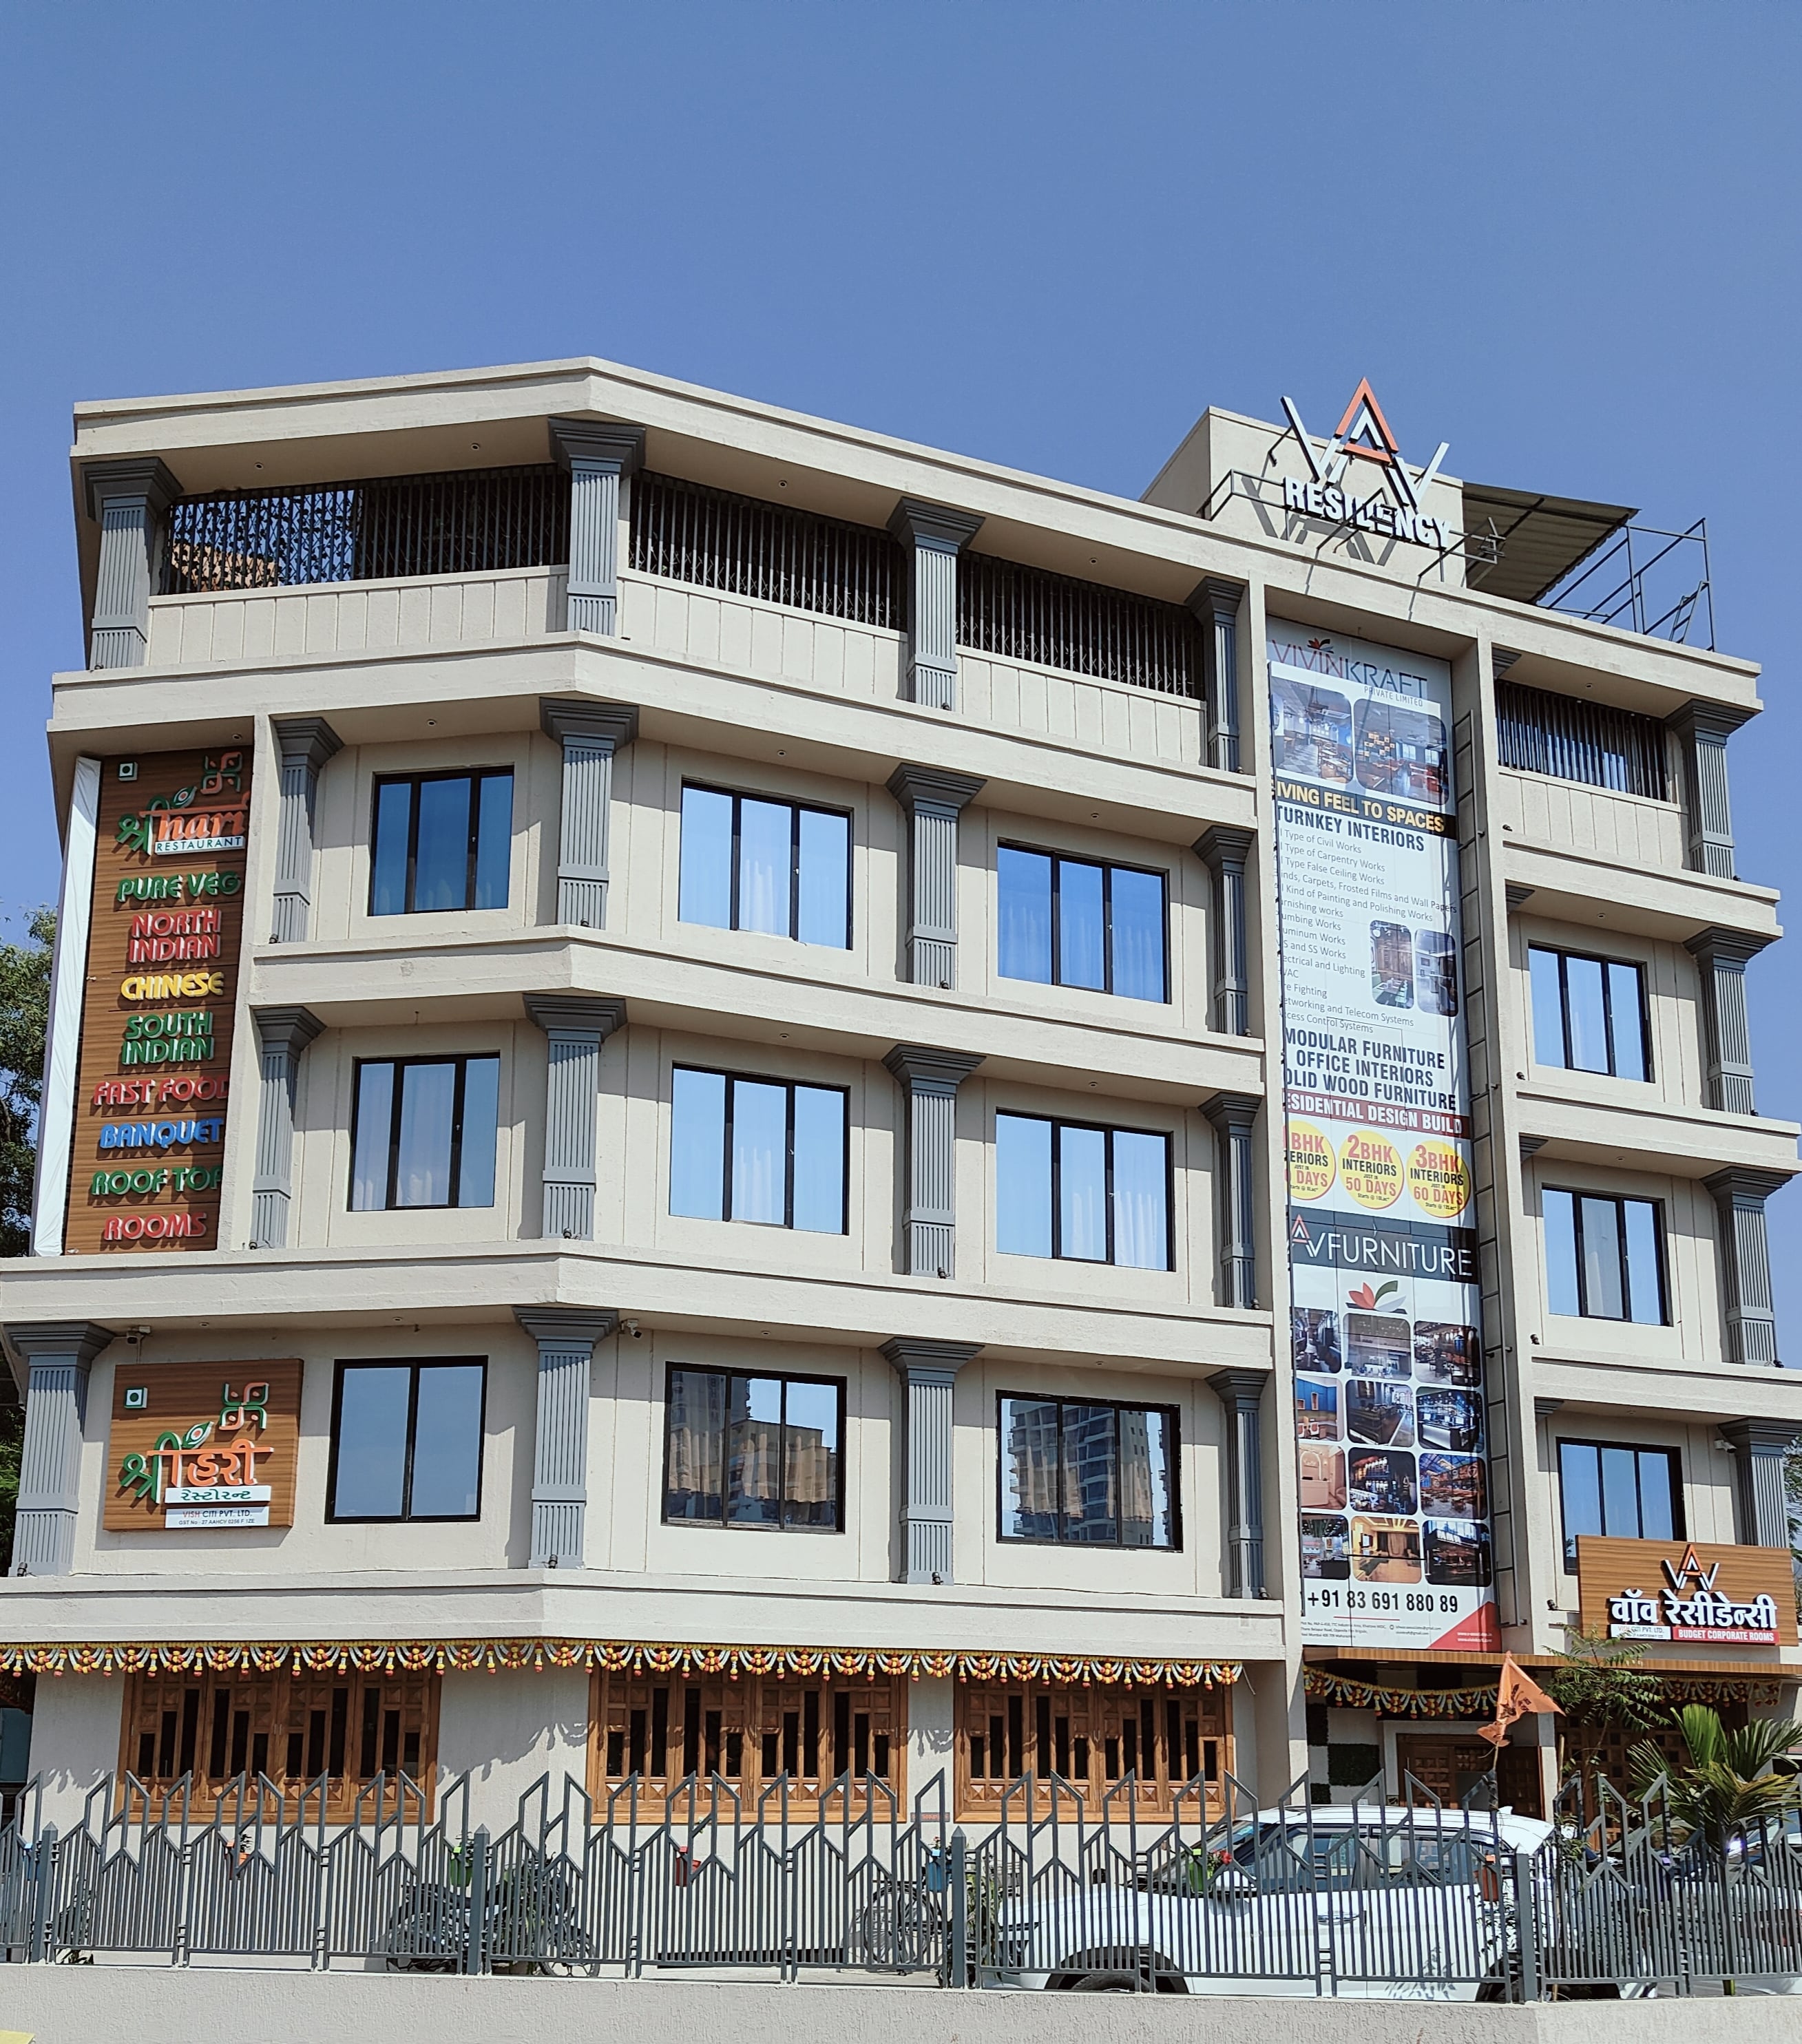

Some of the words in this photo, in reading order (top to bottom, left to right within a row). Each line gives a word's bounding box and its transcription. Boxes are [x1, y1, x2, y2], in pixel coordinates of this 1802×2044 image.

[1364, 686, 1394, 700] PRIVATE
[1395, 694, 1423, 707] LIMITED
[1277, 781, 1319, 805] IVING
[1324, 792, 1359, 814] FEEL
[1361, 800, 1383, 819] TO
[1387, 805, 1445, 832] SPACES
[157, 836, 241, 852] RESTAURANT
[1284, 829, 1304, 841] Type
[1317, 836, 1333, 847] Civil
[1336, 841, 1361, 853] Works
[1348, 820, 1424, 851] INTERIORS
[1284, 843, 1305, 854] Type
[1317, 850, 1358, 867] Carpentry
[1360, 859, 1385, 872] Works
[1285, 856, 1305, 868] Type
[1308, 862, 1328, 873] False
[1330, 867, 1357, 881] Ceiling
[1359, 872, 1384, 885] Works
[117, 875, 182, 902] PURE
[187, 871, 240, 896] VEG
[1281, 871, 1300, 883] inds,
[1302, 874, 1337, 890] Carpets,
[1339, 882, 1368, 895] Frosted
[1371, 889, 1392, 900] Films
[1394, 895, 1409, 903] and
[1411, 896, 1428, 907] Wall
[1431, 900, 1457, 913] Papers
[1283, 900, 1317, 914] rnishing
[1319, 907, 1343, 917] works
[1286, 885, 1304, 896] Kind
[1317, 891, 1350, 907] Painting
[1352, 900, 1368, 909] and
[1370, 902, 1405, 918] Polishing
[1407, 909, 1432, 922] Works
[132, 909, 221, 937] NORTH
[1282, 914, 1313, 927] umbing
[1315, 918, 1341, 931] Works
[1283, 927, 1317, 940] uminum
[1319, 933, 1345, 945] Works
[129, 934, 220, 962] INDIAN
[1290, 943, 1306, 951] and
[1308, 945, 1318, 953] SS
[1320, 947, 1346, 959] Works
[1284, 956, 1312, 967] ectrical
[1314, 961, 1330, 970] and
[1333, 963, 1365, 978] Lighting
[121, 971, 225, 1000] CHINESE
[1294, 984, 1328, 999] Fighting
[126, 1011, 213, 1039] SOUTH
[1284, 998, 1325, 1013] etworking
[1327, 1005, 1343, 1013] and
[1345, 1007, 1379, 1020] Telecom
[1381, 1013, 1414, 1026] Systems
[1286, 1013, 1305, 1021] cess
[1307, 1014, 1338, 1027] Control
[1339, 1020, 1373, 1033] Systems
[122, 1037, 213, 1065] INDIAN
[1363, 1040, 1445, 1069] FURNITURE
[1297, 1050, 1350, 1073] OFFICE
[1356, 1060, 1433, 1087] INTERIORS
[94, 1079, 154, 1106] FAST
[159, 1075, 229, 1102] FOOD
[1287, 1068, 1317, 1088] OLID
[1323, 1074, 1368, 1096] WOOD
[1374, 1082, 1456, 1111] FURNITURE
[100, 1118, 223, 1148] BANQUET
[1368, 1104, 1418, 1128] DESIGN
[1422, 1114, 1463, 1134] BUILD
[1291, 1132, 1325, 1153] BHK
[1348, 1135, 1393, 1163] 2BHK
[1290, 1150, 1328, 1167] ERIORS
[1342, 1158, 1396, 1177] INTERIORS
[1415, 1144, 1459, 1172] 3BHK
[92, 1168, 167, 1196] ROOF
[172, 1166, 222, 1191] TOP
[1297, 1170, 1328, 1187] DAYS
[1345, 1177, 1361, 1192] 50
[1365, 1179, 1396, 1197] DAYS
[1410, 1168, 1464, 1186] INTERIORS
[1414, 1186, 1429, 1201] 60
[1434, 1189, 1463, 1205] DAYS
[104, 1212, 207, 1240] ROOMS
[202, 1510, 217, 1518] CITI
[1347, 1590, 1366, 1609] 83
[1372, 1592, 1398, 1610] 691
[1406, 1593, 1434, 1612] 880
[1440, 1595, 1458, 1613] 89
[1609, 1588, 1659, 1623] वॉव
[1663, 1588, 1778, 1629] रेसीडेन्सी
[1678, 1628, 1706, 1639] BUDGET
[1707, 1630, 1748, 1641] CORPORATE
[1749, 1631, 1774, 1642] ROOMS
